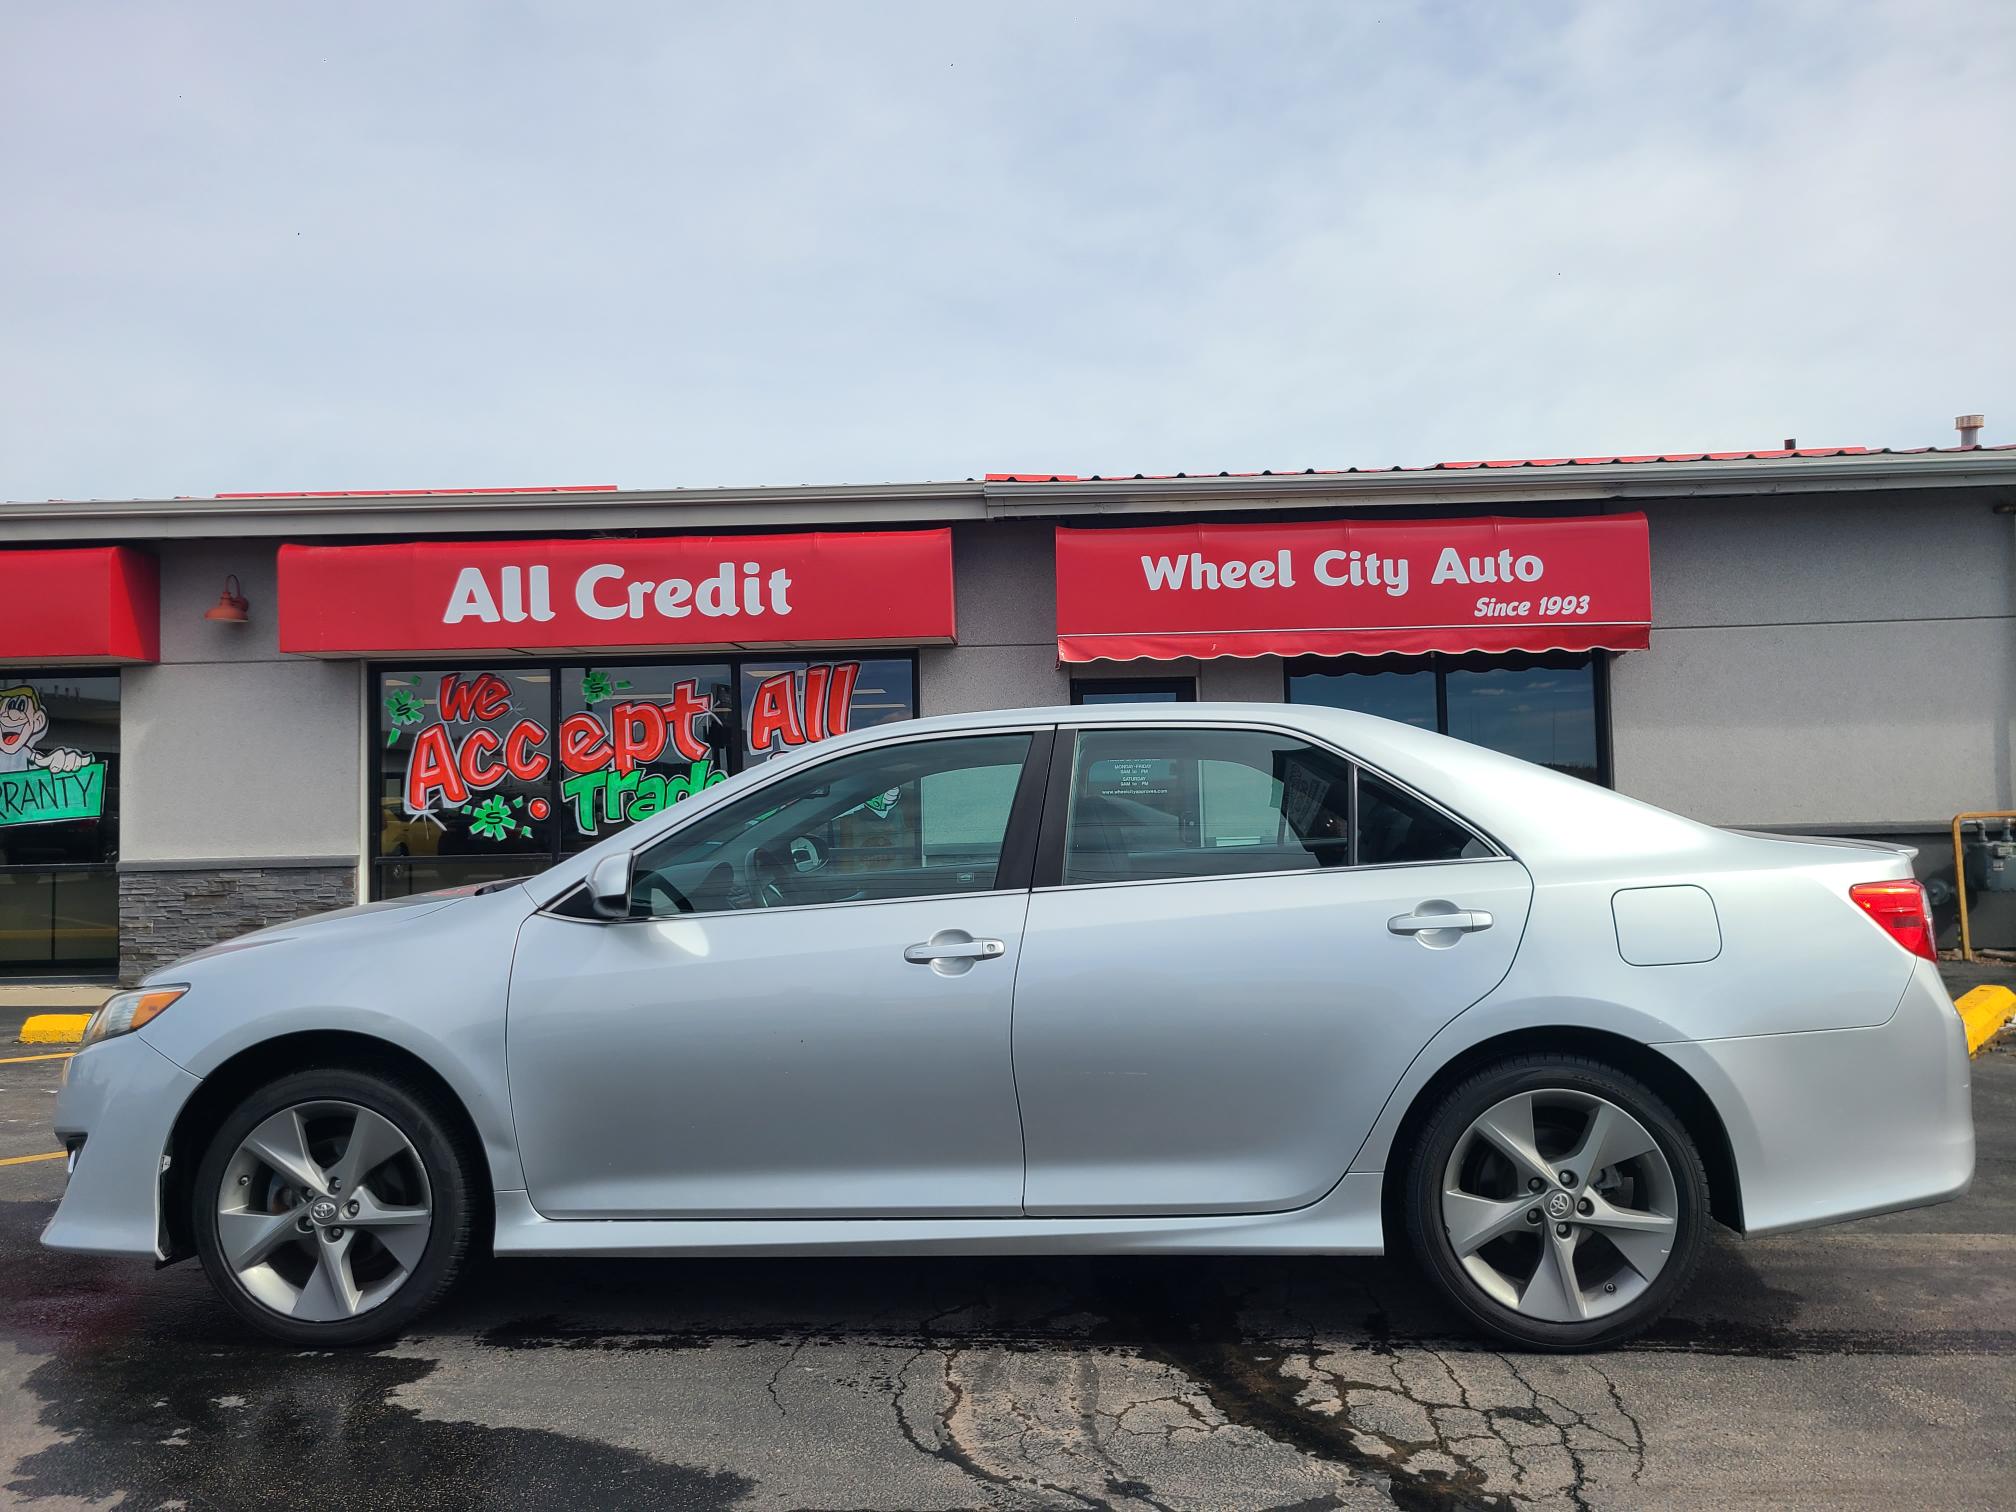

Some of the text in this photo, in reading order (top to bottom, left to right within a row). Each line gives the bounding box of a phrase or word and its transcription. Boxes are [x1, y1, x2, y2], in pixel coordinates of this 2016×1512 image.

[443, 562, 793, 624] All Credit
[1141, 547, 1544, 597] Wheel City Auto
[1474, 595, 1590, 617] Since 1993
[438, 672, 514, 724] We
[405, 660, 861, 815] Accept All
